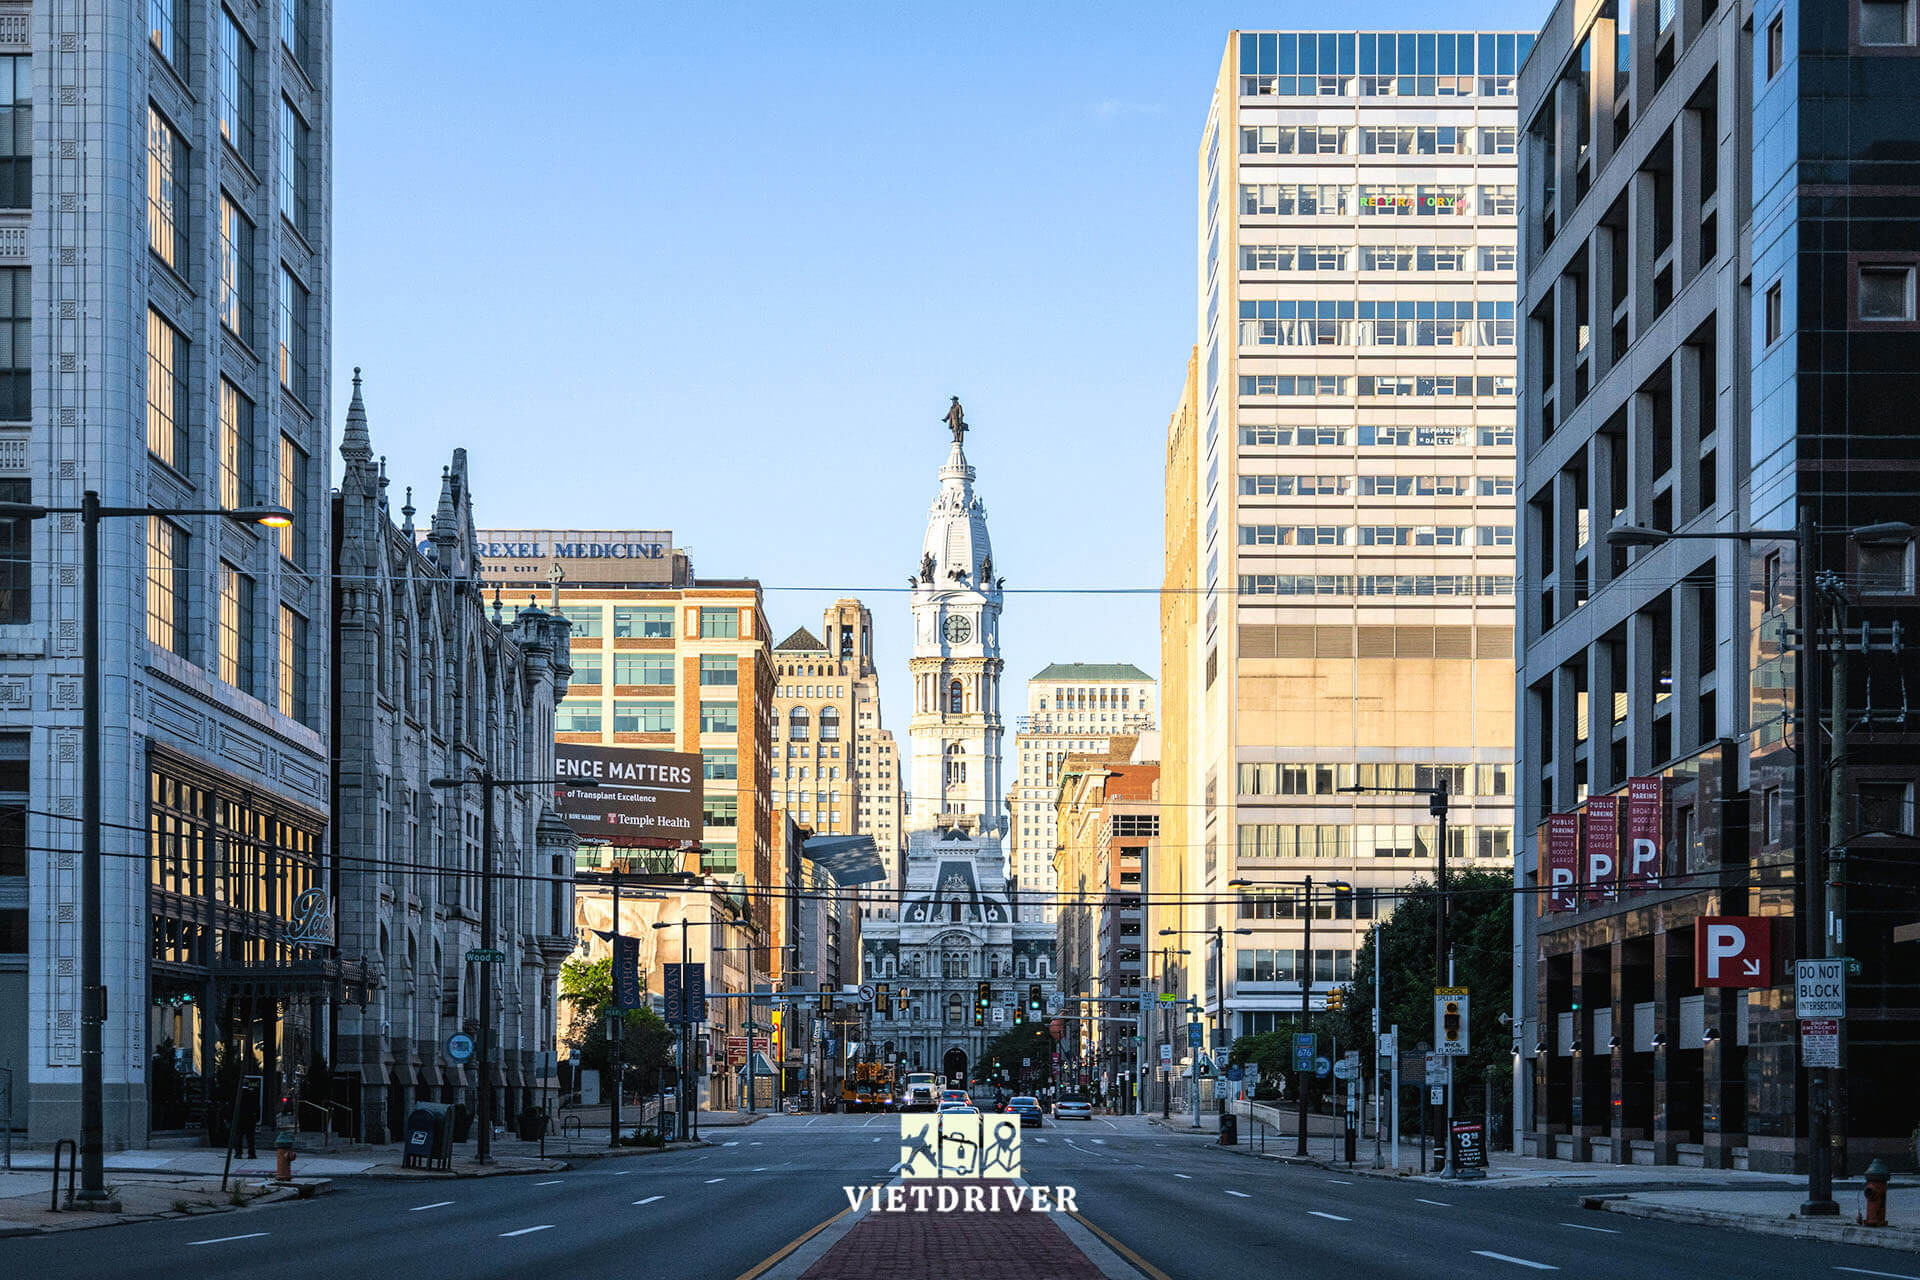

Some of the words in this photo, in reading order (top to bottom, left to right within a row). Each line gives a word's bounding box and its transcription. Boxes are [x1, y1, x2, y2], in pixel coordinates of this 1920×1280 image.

[553, 542, 665, 560] MEDICINE
[555, 758, 604, 778] ENCE
[609, 761, 692, 784] MATTERS
[567, 789, 576, 798] of
[577, 790, 616, 802] Transplant
[617, 792, 657, 803] Excellence
[1631, 792, 1657, 800] PARKING
[1589, 801, 1614, 809] PUBLIC
[618, 813, 655, 829] Temple
[657, 815, 691, 829] Health
[1589, 810, 1614, 818] PARKING
[1552, 818, 1574, 826] PUBLIC
[1632, 839, 1656, 874] P
[1590, 854, 1612, 887] P
[1552, 868, 1573, 900] P
[466, 953, 491, 962] Wood
[495, 954, 504, 962] St
[1707, 925, 1746, 979] P
[623, 940, 634, 1006] CATHOLIC
[1799, 965, 1815, 979] DO
[1818, 965, 1840, 979] NOT
[667, 966, 679, 1020] ROMAN
[692, 967, 702, 1020] CATHOLIC
[1800, 984, 1840, 998] BLOCK
[1799, 1000, 1842, 1010] INTERSECTION
[1297, 1048, 1312, 1057] 676
